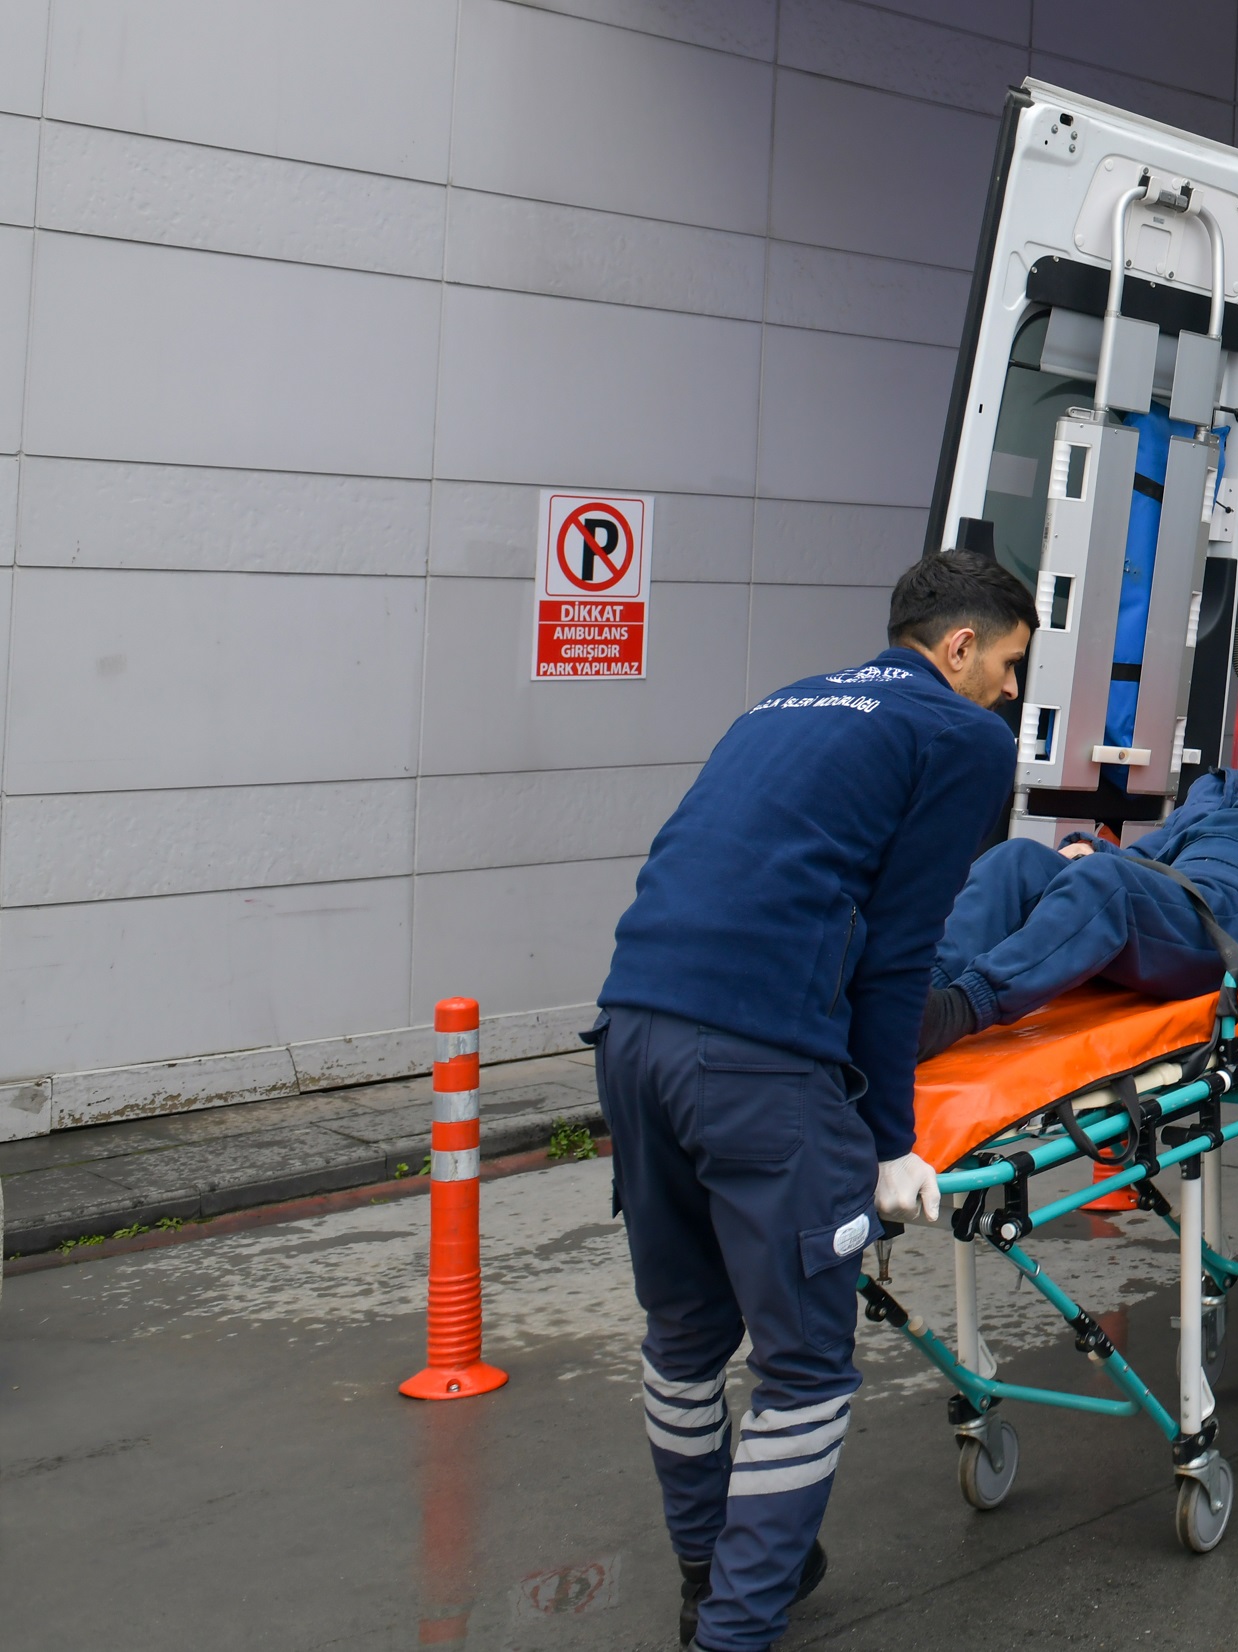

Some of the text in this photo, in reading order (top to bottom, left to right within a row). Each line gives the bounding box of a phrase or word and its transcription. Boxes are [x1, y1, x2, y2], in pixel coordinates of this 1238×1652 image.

[560, 601, 624, 622] DİKKAT
[553, 626, 629, 640] AMBULANS
[540, 661, 639, 676] PARK YAPILMAZ
